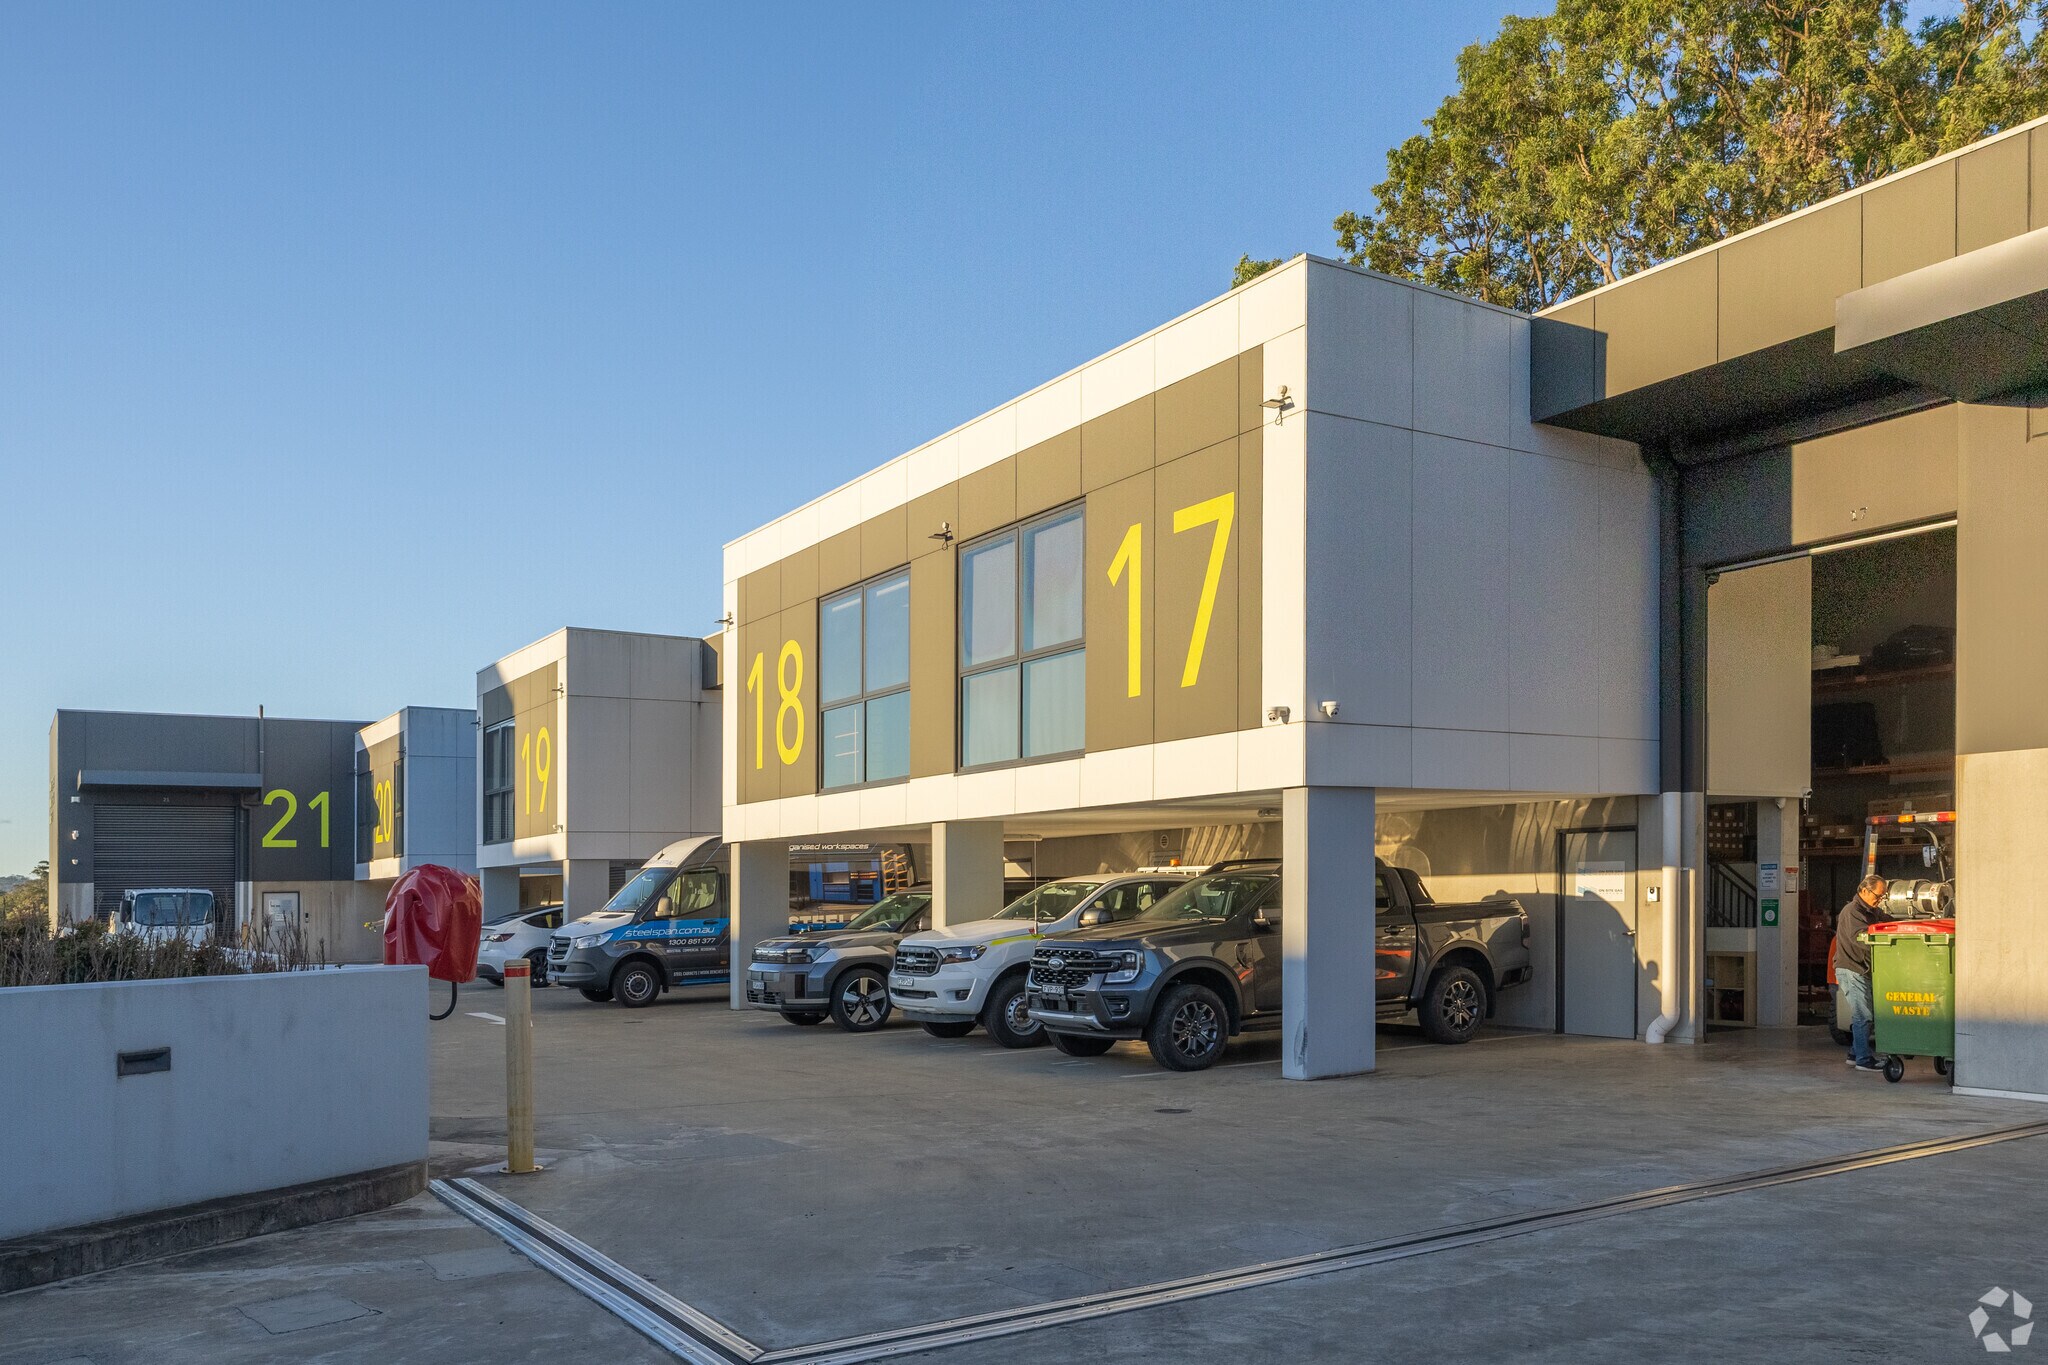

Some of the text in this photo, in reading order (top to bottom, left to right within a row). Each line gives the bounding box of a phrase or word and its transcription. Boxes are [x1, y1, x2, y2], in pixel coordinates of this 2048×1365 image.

[1106, 491, 1235, 698] 17
[747, 639, 805, 770] 18
[521, 726, 551, 816] 19
[262, 788, 330, 848] 21
[375, 779, 392, 844] 20
[821, 842, 869, 851] workspaces
[625, 927, 715, 937] steelspan.com.au
[1885, 991, 1937, 1003] GENERAL
[1893, 1005, 1931, 1016] WASTE
